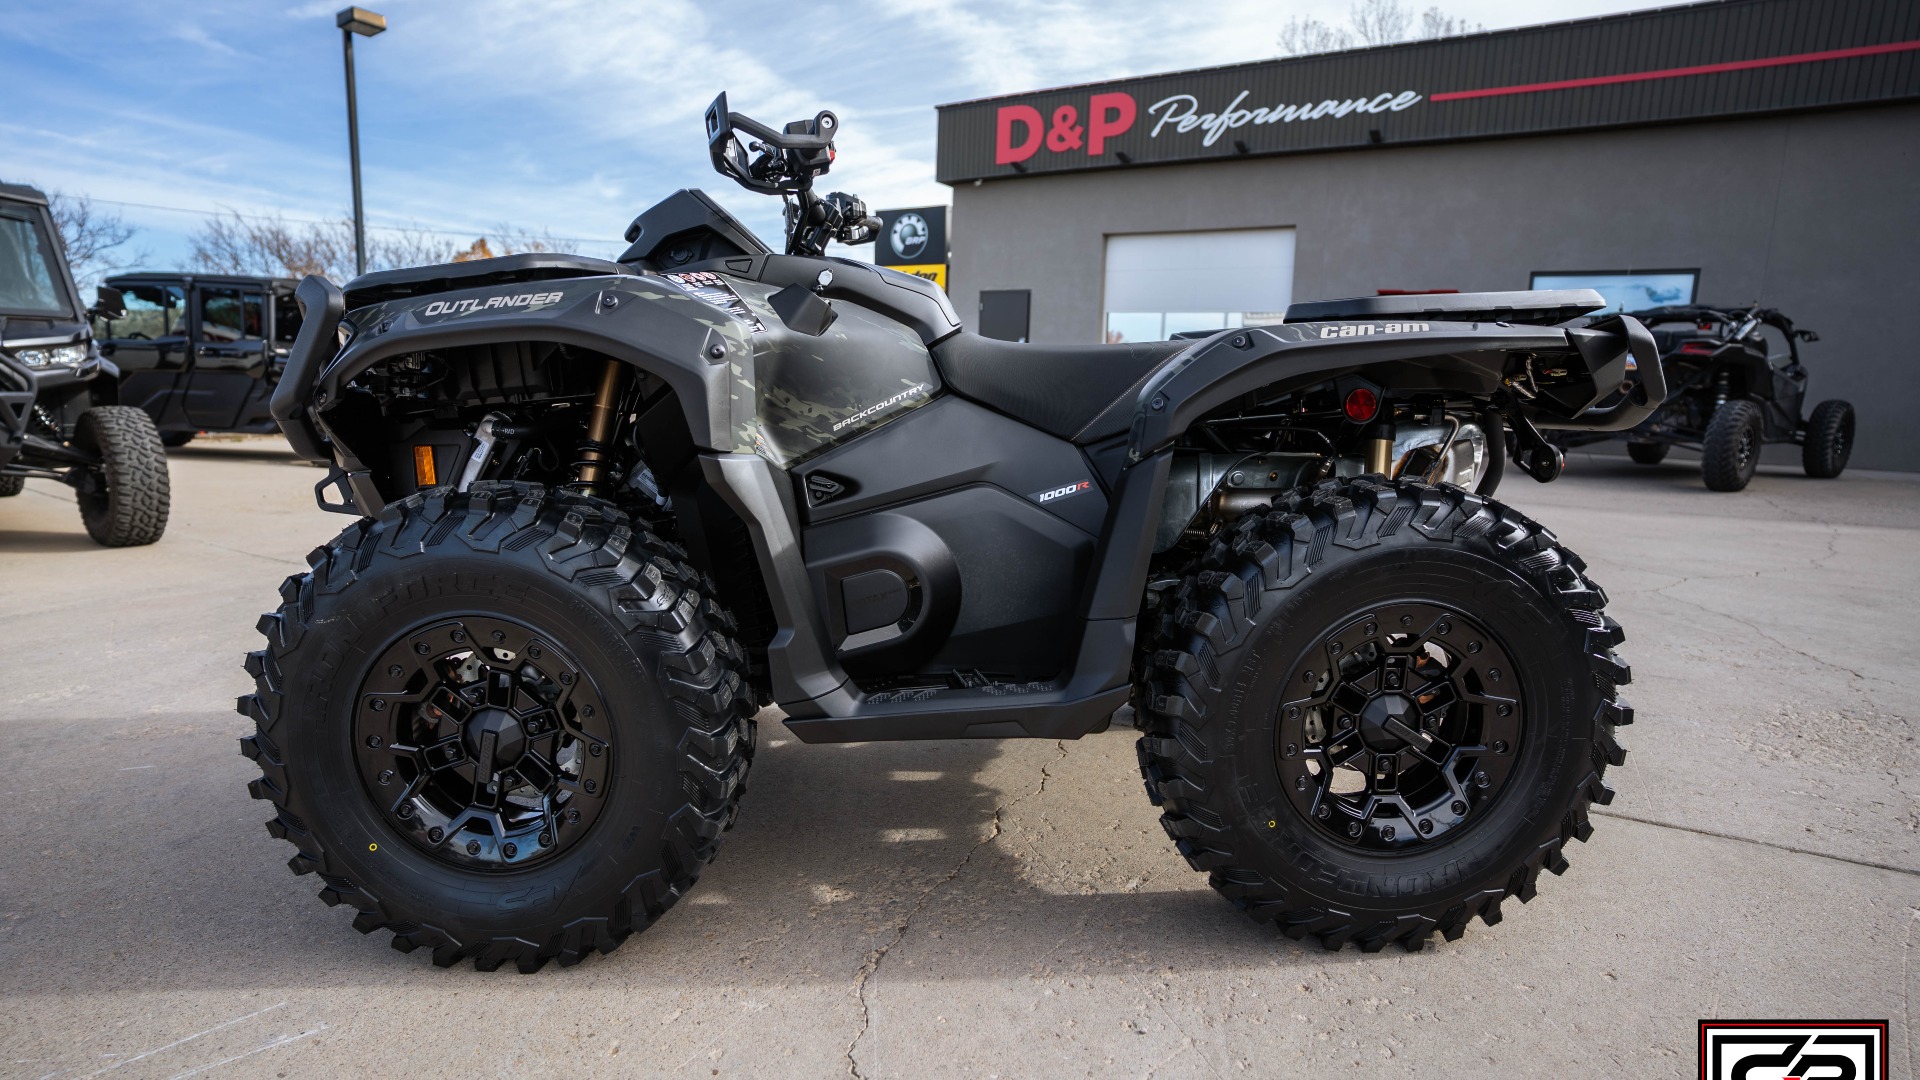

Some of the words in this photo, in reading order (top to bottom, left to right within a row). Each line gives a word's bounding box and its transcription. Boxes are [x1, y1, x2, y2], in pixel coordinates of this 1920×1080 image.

[995, 91, 1137, 165] D&P
[1148, 90, 1422, 147] Performance
[905, 236, 926, 246] BRP
[425, 291, 564, 316] OUTLANDER
[1320, 323, 1430, 339] can-am
[833, 383, 925, 431] BACKCOUNTRY
[1039, 481, 1090, 502] 1000R
